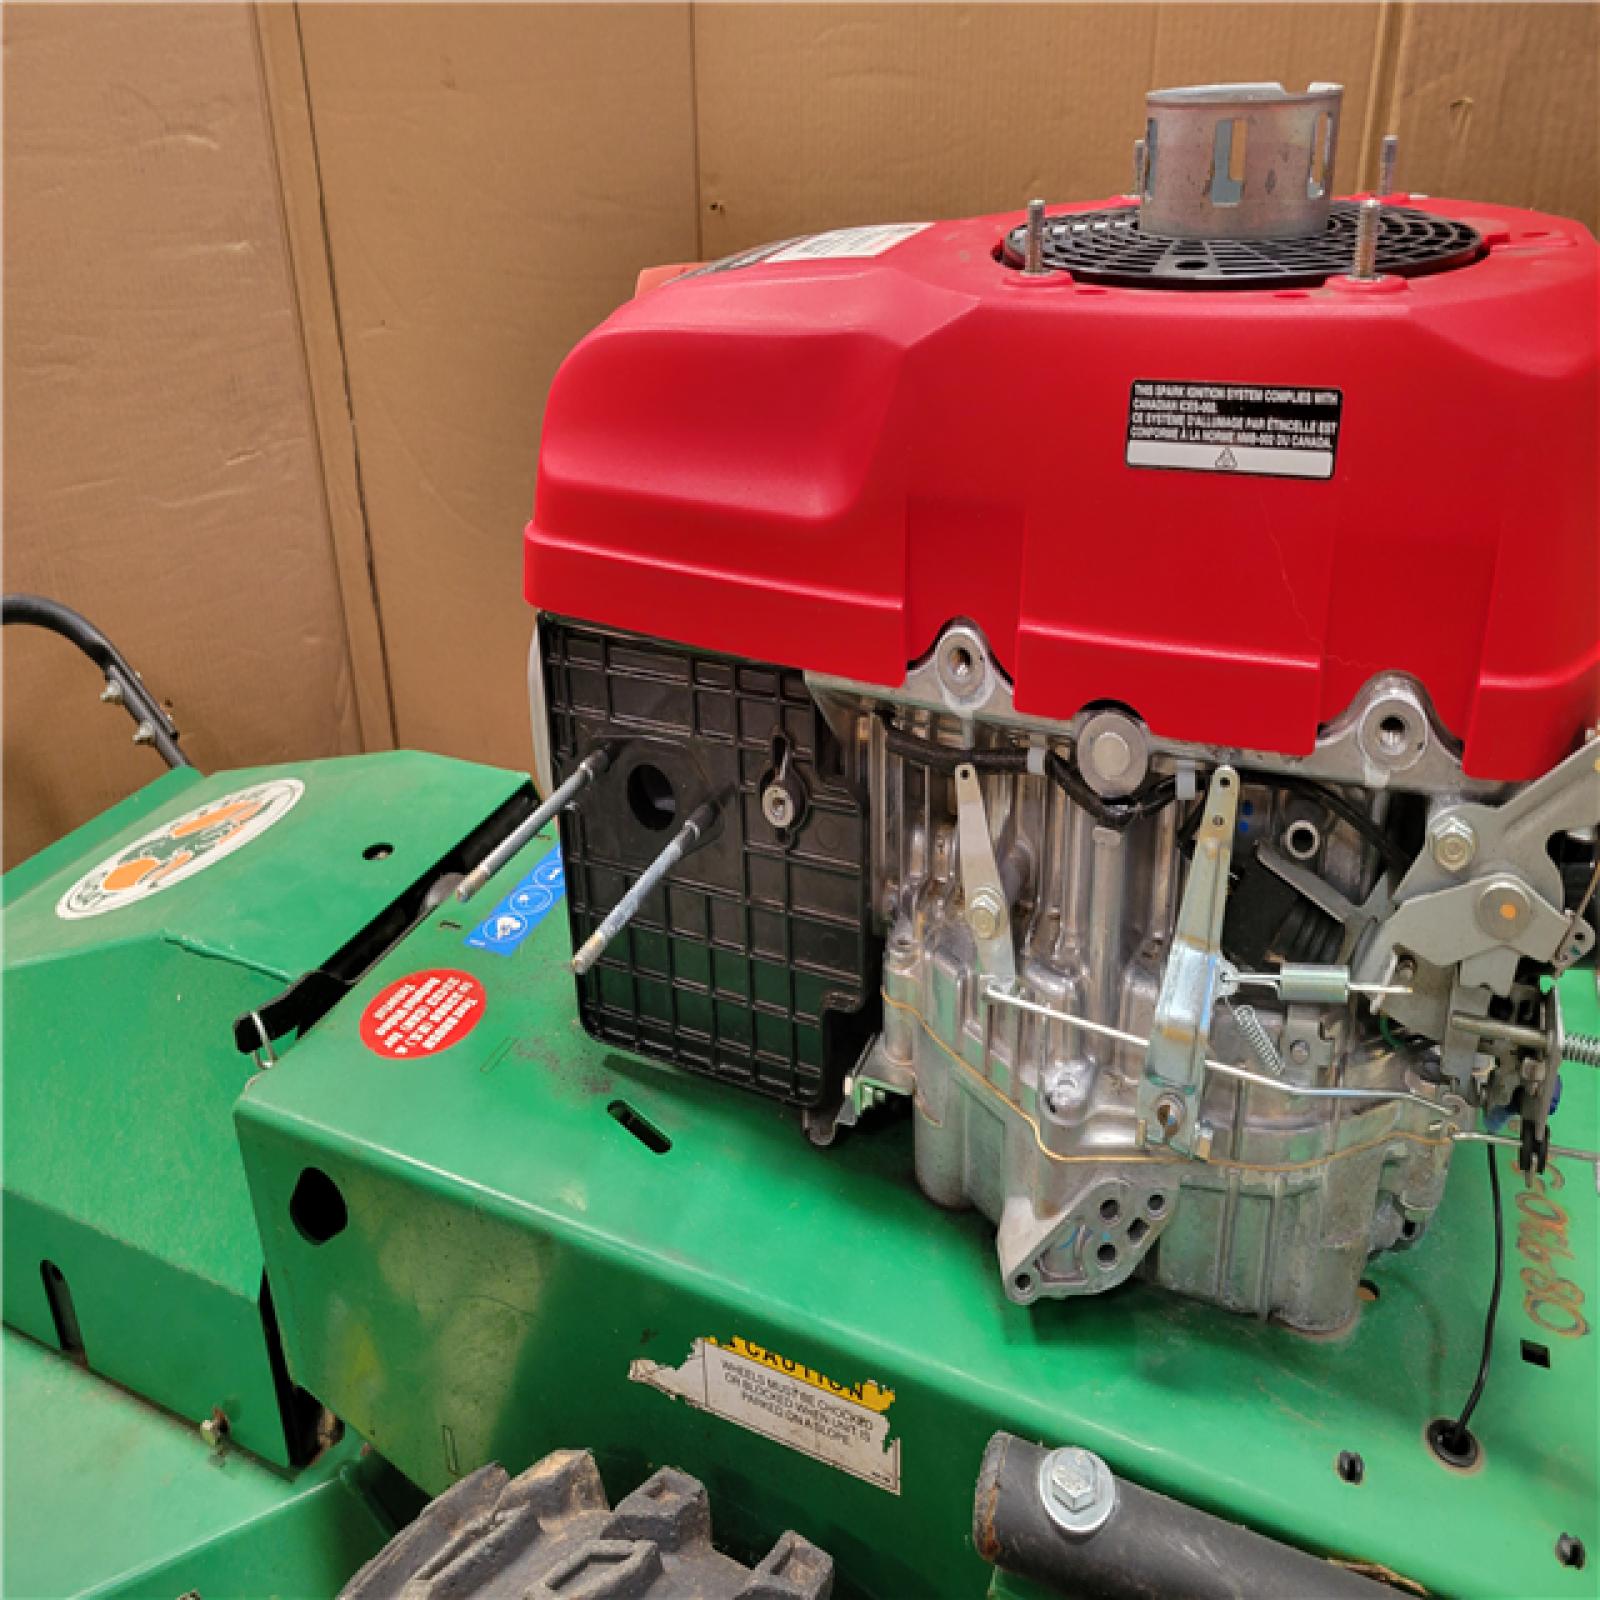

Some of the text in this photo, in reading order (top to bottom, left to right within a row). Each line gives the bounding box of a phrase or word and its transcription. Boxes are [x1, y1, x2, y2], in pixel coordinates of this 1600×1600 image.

[1134, 397, 1179, 411] CANADIAN
[1135, 384, 1338, 406] THIS SPARK IGNITION SYSTEM COMPLIES WITH
[1132, 412, 1144, 425] CE
[1245, 417, 1266, 430] PAR
[1319, 420, 1337, 436] EST
[1131, 425, 1179, 440] CONFORME
[1189, 428, 1201, 441] LA
[1202, 429, 1234, 443] NORME
[1276, 434, 1291, 446] DU
[722, 1358, 766, 1387] WHEELS
